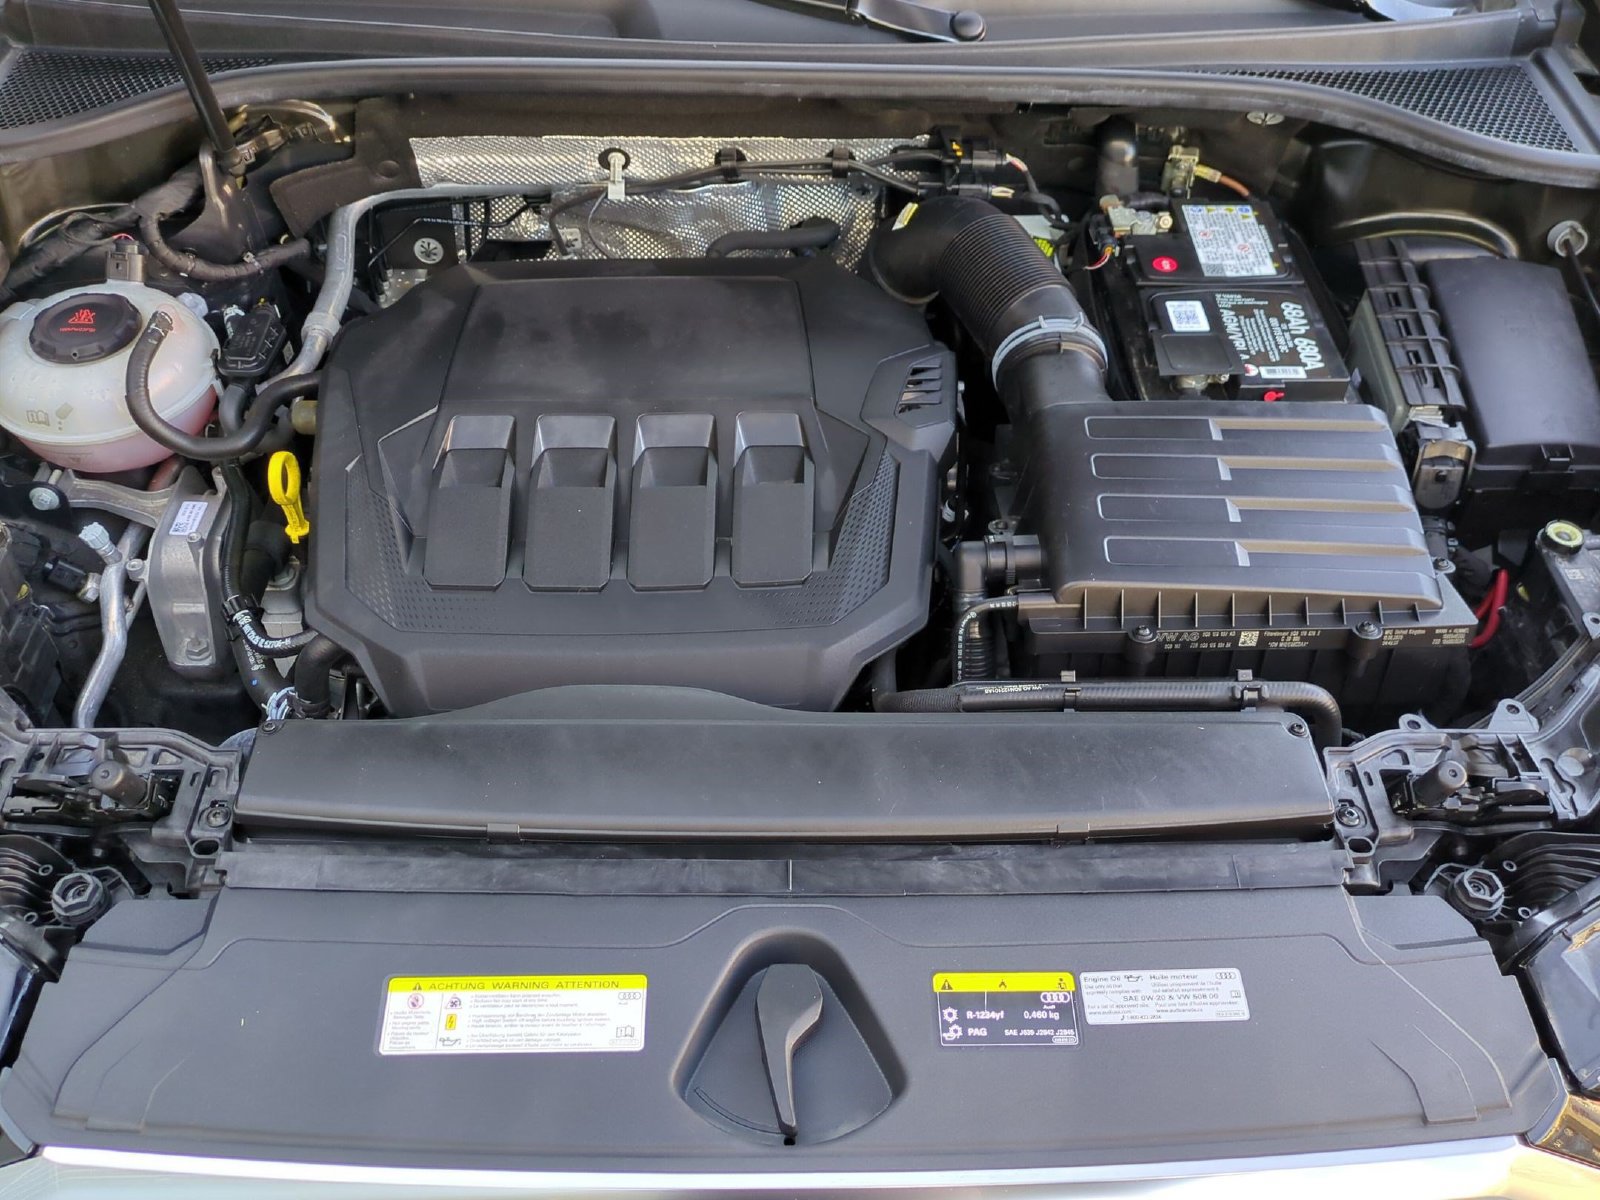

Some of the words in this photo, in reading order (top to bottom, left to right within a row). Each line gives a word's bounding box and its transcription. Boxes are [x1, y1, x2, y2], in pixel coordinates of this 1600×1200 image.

[1280, 302, 1310, 334] 68Ah
[1294, 337, 1325, 370] 680A
[429, 982, 485, 990] ACHTUNG
[555, 980, 620, 988] ATTENTION
[966, 1010, 1004, 1021] R-1234yf
[1049, 1010, 1060, 1020] kg
[967, 1028, 988, 1036] PAG
